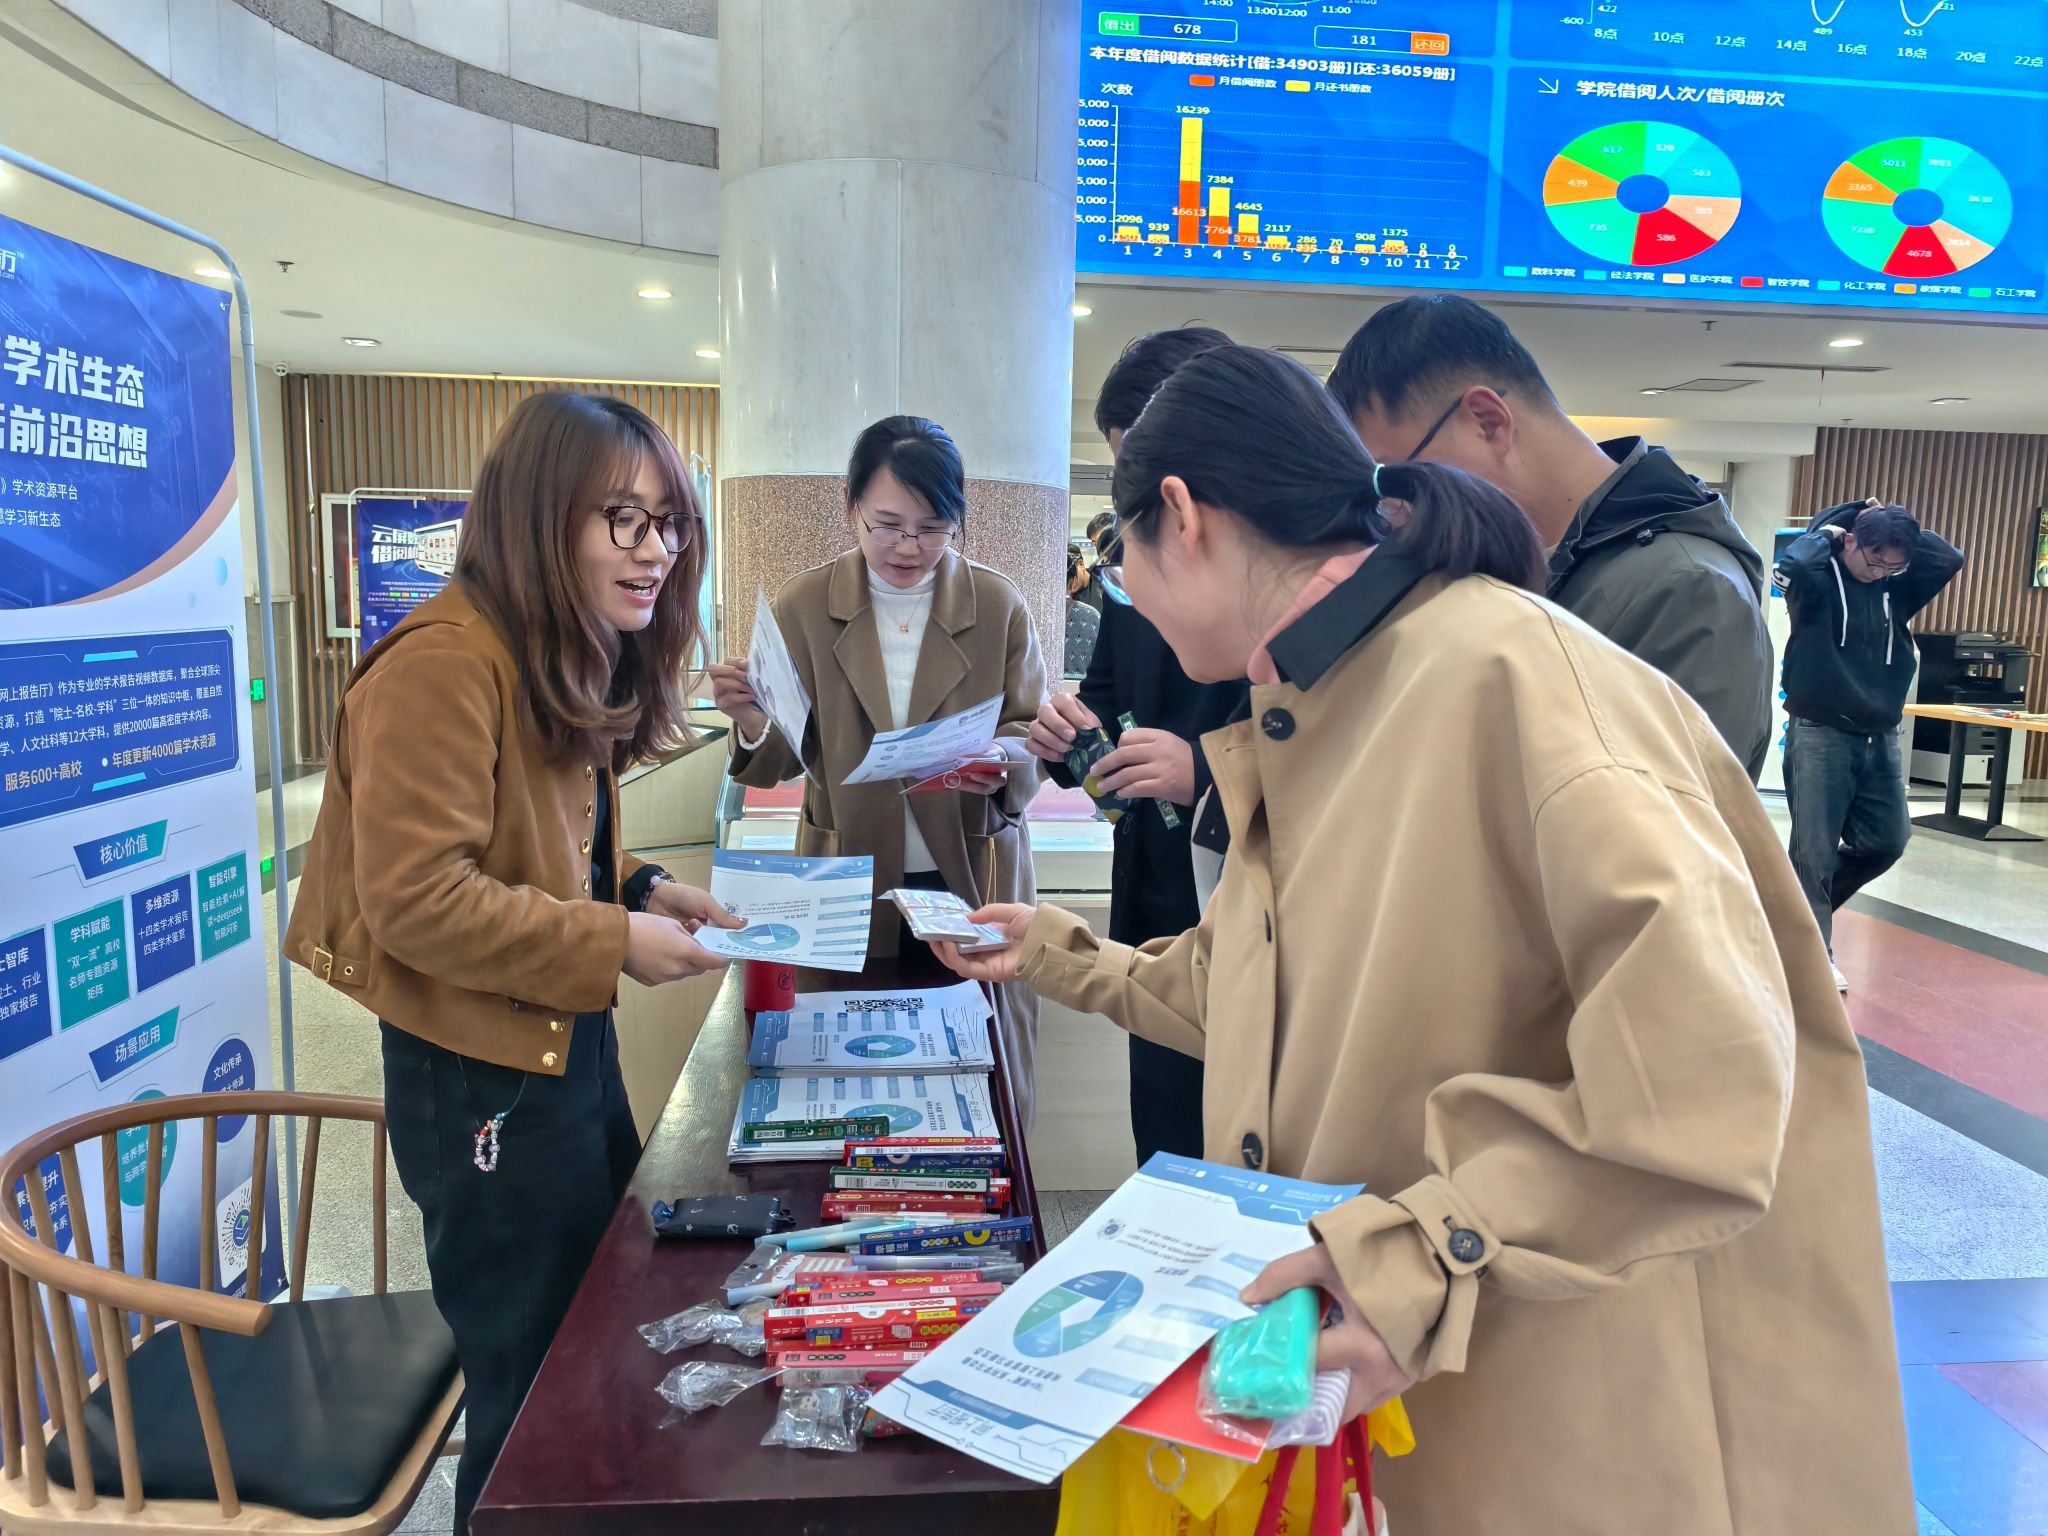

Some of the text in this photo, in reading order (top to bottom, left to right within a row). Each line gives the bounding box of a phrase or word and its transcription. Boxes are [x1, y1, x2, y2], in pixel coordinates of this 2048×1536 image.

[1247, 6, 1277, 15] 13:00
[1277, 8, 1308, 18] 12:00
[1321, 5, 1352, 15] 11:00
[1104, 19, 1135, 32] 借出
[1559, 17, 1584, 25] -600
[1173, 23, 1202, 35] 678
[1904, 28, 1923, 37] 453
[1351, 34, 1377, 46] 181
[1414, 38, 1445, 51] 还回
[1593, 28, 2044, 68] 8点 10点 12点 14点 16点 18点 20点 22点
[1101, 82, 1134, 96] 次数
[1576, 79, 1786, 107] 学院借阅人次/借阅册次
[1176, 105, 1211, 115] 16239
[1882, 159, 1906, 168] 5011
[1207, 175, 1234, 184] 7384
[1568, 179, 1588, 187] 439
[1235, 202, 1263, 211] 4645
[1115, 214, 1144, 224] 2096
[1148, 223, 1170, 232] 939
[1264, 223, 1291, 233] 2117
[1382, 228, 1408, 237] 1375
[1098, 234, 1106, 243] 0
[1297, 236, 1317, 244] 286
[1355, 233, 1376, 241] 908
[1656, 233, 1676, 242] 586
[1124, 245, 1461, 270] 1 2 3 4 5 6 7 8 9 10 11 12
[1906, 249, 1932, 258] 4678
[1844, 281, 1887, 291] 化工学院
[1995, 288, 2037, 298] 石工学院
[3, 334, 145, 409] 学术生态
[0, 403, 148, 468] 前沿思想
[112, 733, 217, 768] 年度更新4000篇学术资源
[5, 760, 83, 792] 服务600+高校
[100, 834, 148, 865] 核心价值
[208, 866, 238, 888] 智能引擎
[145, 888, 180, 914] 多维资源
[70, 916, 111, 943] 学科赋能
[138, 910, 189, 939] 十四类学术报告
[143, 928, 186, 956] 四类学术鉴赏
[68, 958, 119, 989] 名师专题资源
[0, 971, 42, 1000] 士、行业
[87, 984, 104, 1000] 矩阵
[115, 1025, 161, 1063] 场景应用
[213, 1052, 243, 1081] 文化传承
